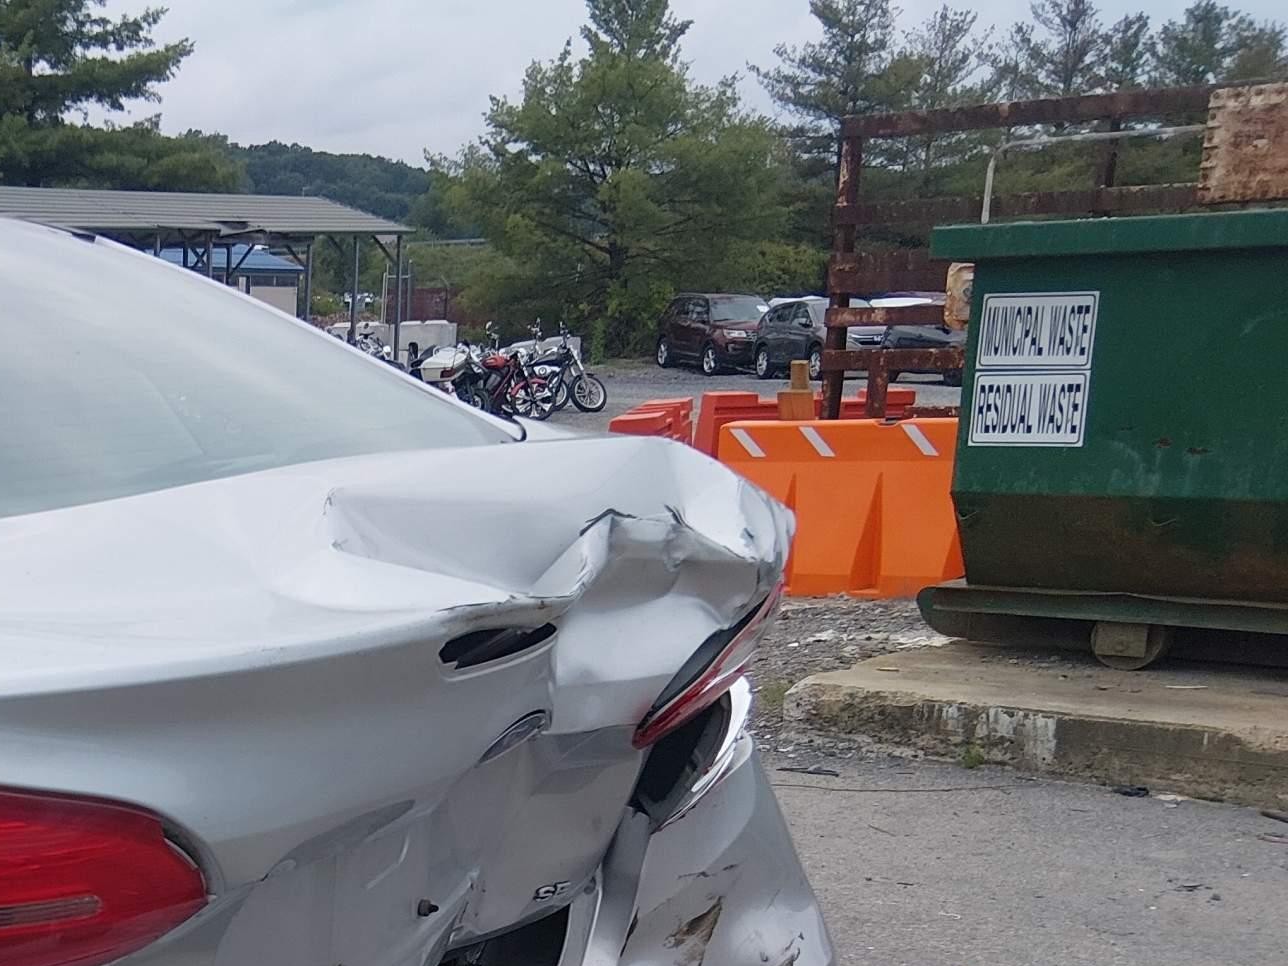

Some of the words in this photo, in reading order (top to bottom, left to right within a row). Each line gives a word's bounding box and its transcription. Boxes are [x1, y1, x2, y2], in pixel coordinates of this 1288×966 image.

[983, 305, 1045, 357] MUNICIPAL
[1047, 304, 1091, 357] WASTE
[975, 383, 1033, 434] RESIDUAL
[1036, 383, 1082, 434] WASTE
[533, 880, 571, 902] SE
